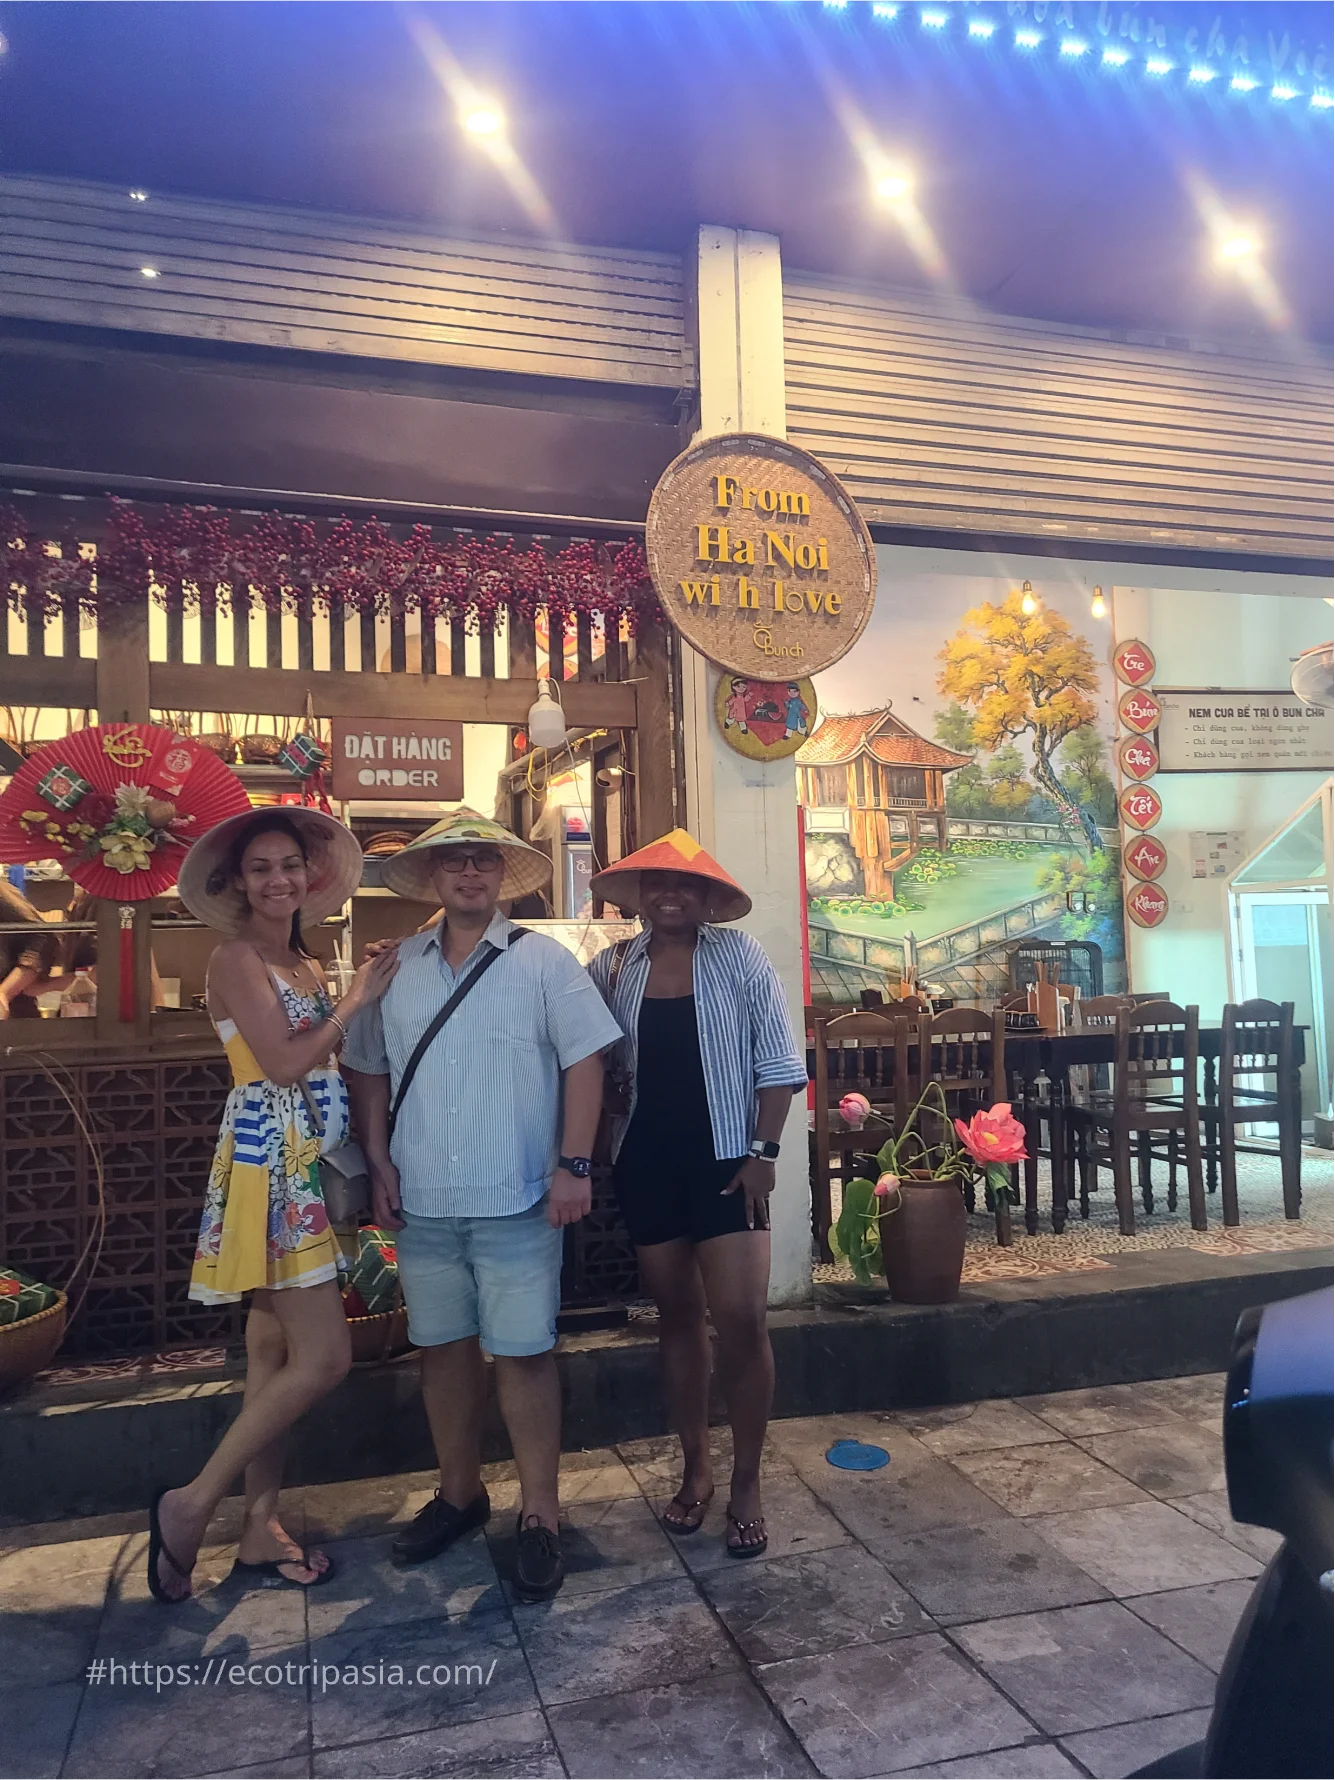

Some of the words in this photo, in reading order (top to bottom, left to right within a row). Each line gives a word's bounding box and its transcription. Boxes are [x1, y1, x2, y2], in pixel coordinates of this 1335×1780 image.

[715, 475, 810, 516] From
[695, 524, 755, 565] Ha
[764, 531, 830, 571] Noi
[774, 580, 842, 616] love
[1127, 701, 1158, 719] Bún
[1188, 708, 1211, 718] NEM
[1214, 708, 1234, 718] CUA
[344, 731, 387, 764] ĐẶT
[392, 731, 452, 761] HÀNG
[358, 768, 438, 787] ORDER
[1130, 795, 1153, 816] Tết
[1134, 846, 1160, 868] An
